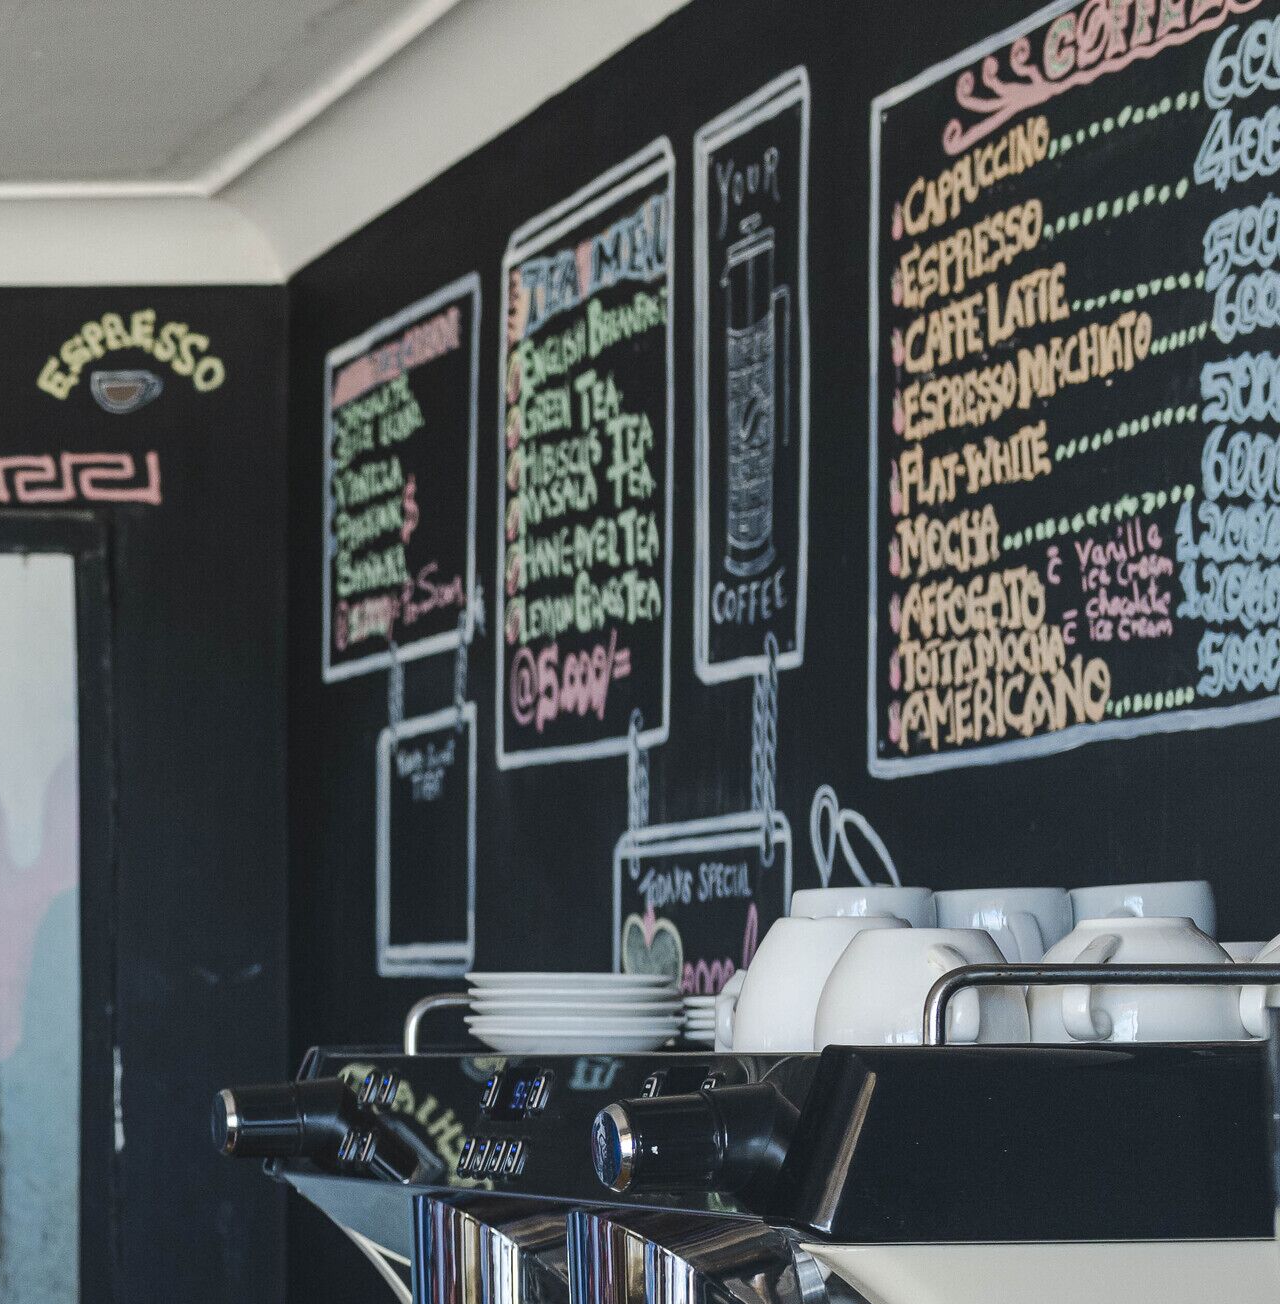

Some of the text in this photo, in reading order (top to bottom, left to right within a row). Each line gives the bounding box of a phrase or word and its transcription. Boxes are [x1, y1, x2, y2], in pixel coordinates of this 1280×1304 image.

[903, 116, 1050, 237] CAPPUCCINO
[901, 198, 1042, 306] ESPRESSO
[36, 307, 226, 400] ESPRESSO
[903, 360, 1017, 441] ESPRESSO
[901, 420, 1052, 516] FLAT-WHITE
[895, 503, 1000, 580] MOCHA
[712, 566, 788, 626] COFFEE
[900, 563, 1046, 644] AFFOGATO
[973, 622, 1067, 684] MOCHA
[900, 654, 1111, 754] AMERICANO
